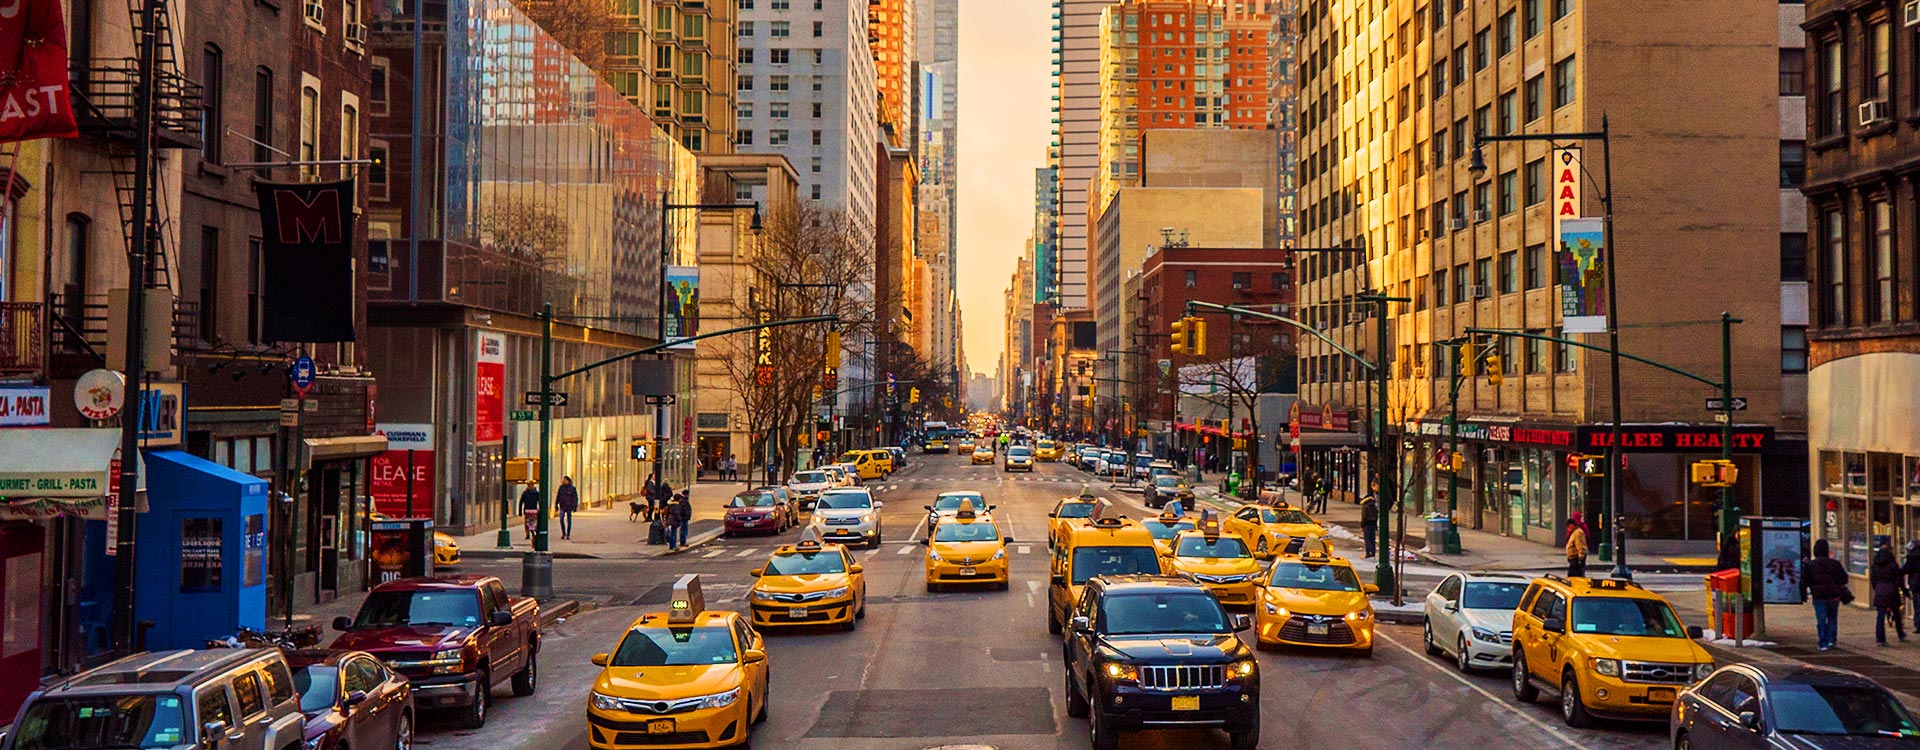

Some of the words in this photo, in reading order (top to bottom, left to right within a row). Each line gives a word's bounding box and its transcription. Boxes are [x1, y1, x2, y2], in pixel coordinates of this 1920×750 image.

[1560, 169, 1575, 215] AAA
[274, 189, 341, 243] M
[16, 396, 44, 415] PASTA
[81, 406, 118, 418] PIZZA
[373, 457, 390, 465] FOR
[37, 479, 66, 489] GRILL
[70, 478, 97, 489] PASTA
